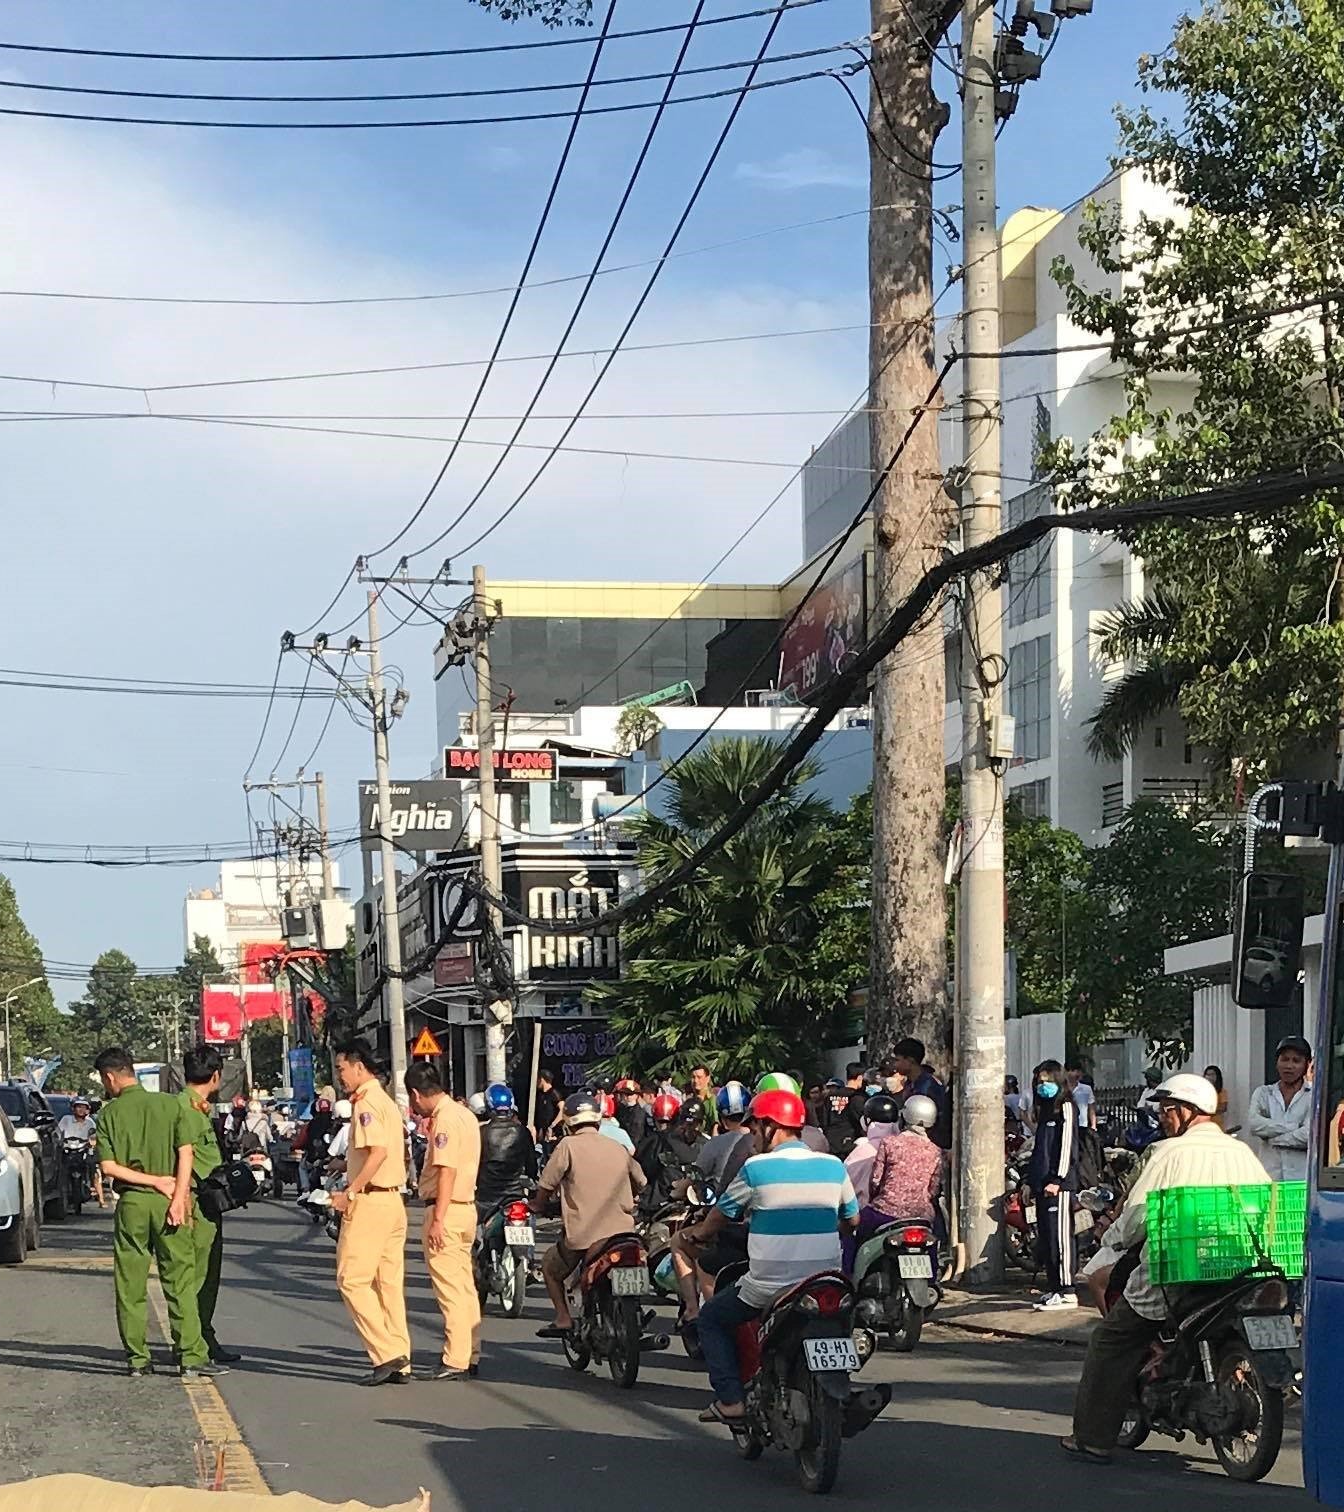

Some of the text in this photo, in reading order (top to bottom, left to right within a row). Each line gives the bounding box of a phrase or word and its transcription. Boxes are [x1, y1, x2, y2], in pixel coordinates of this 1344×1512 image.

[502, 752, 552, 769] LONG
[510, 768, 553, 779] MOBILE
[364, 784, 411, 795] Faion
[531, 935, 617, 968] KINH
[814, 1341, 849, 1354] 49-H1
